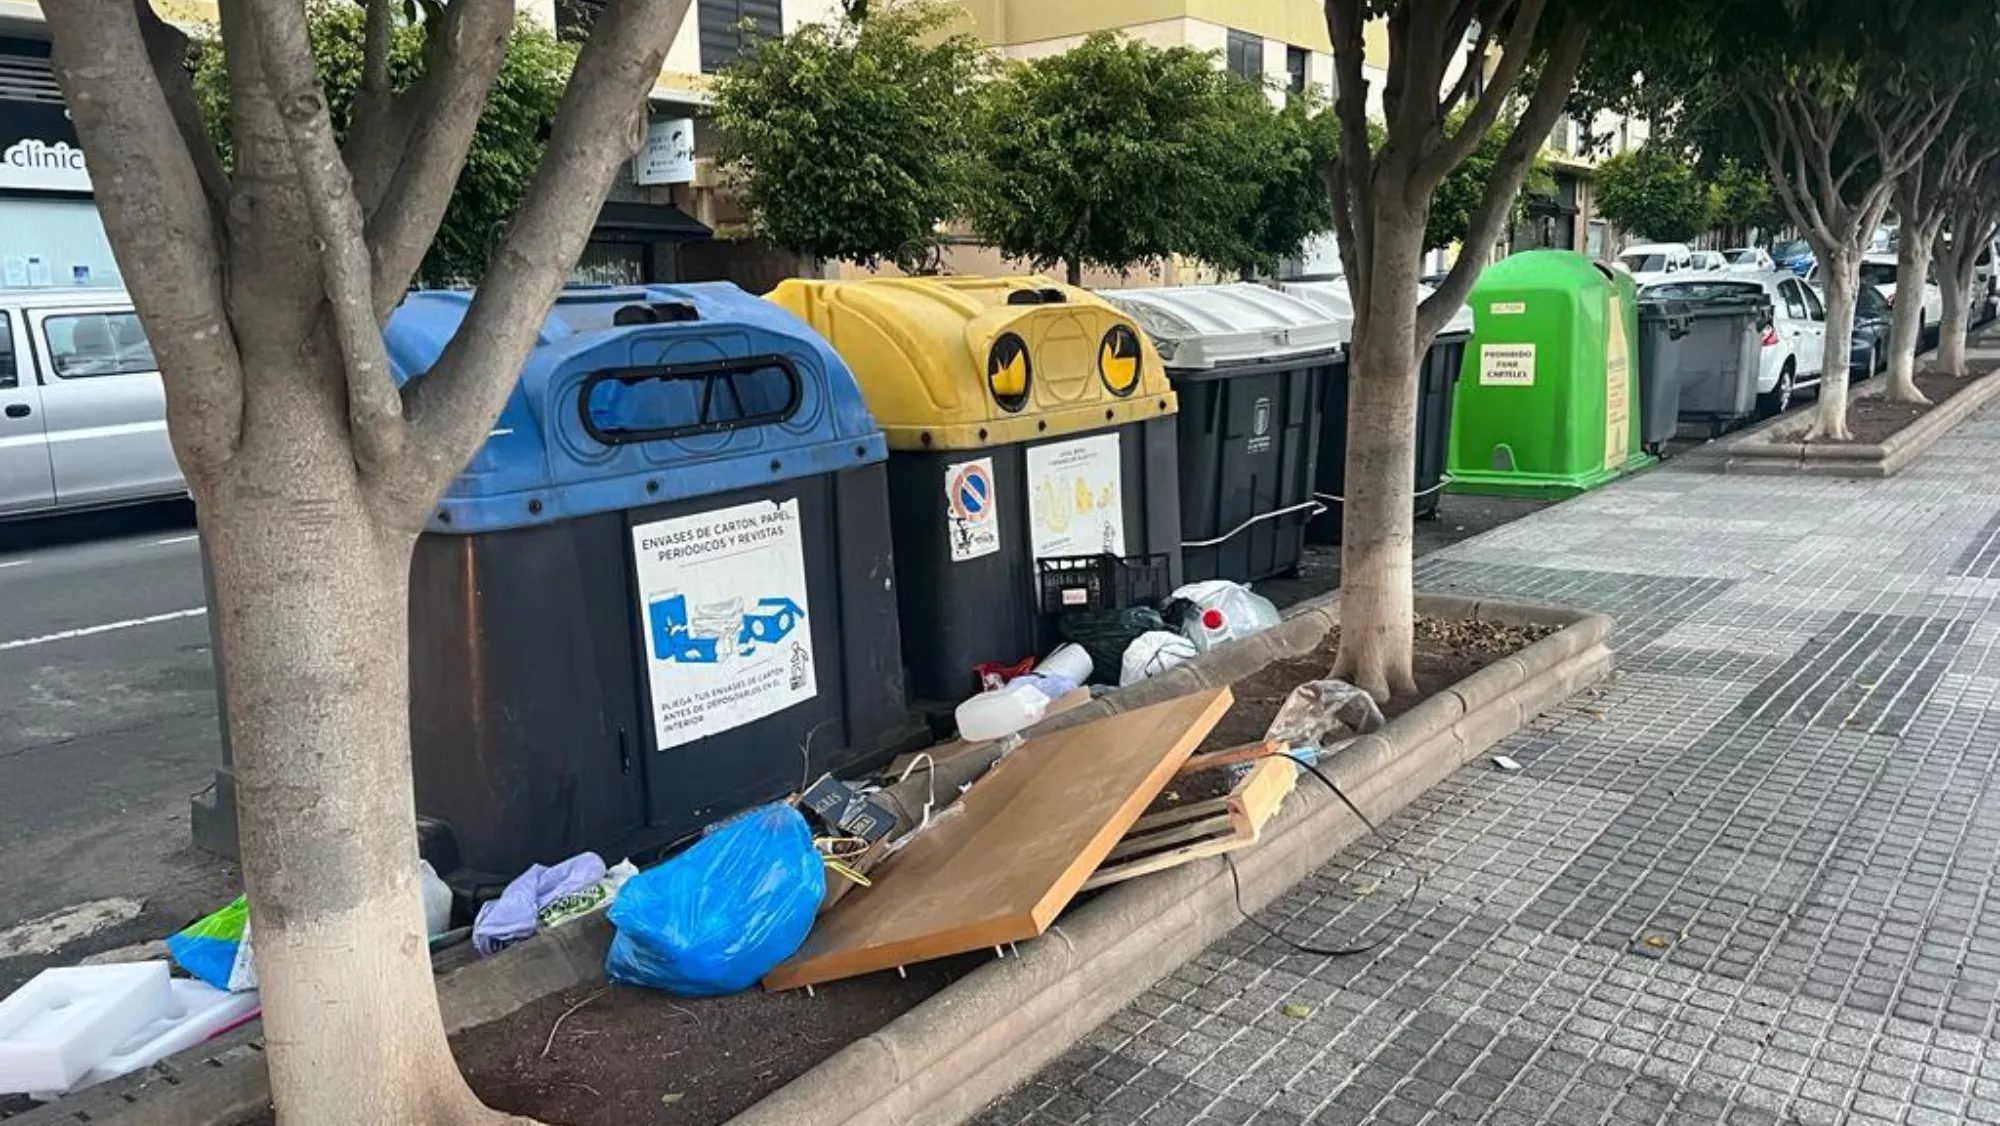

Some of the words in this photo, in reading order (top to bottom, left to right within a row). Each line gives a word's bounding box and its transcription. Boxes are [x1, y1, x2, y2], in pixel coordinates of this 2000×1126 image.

[642, 529, 695, 551] ENVASES
[697, 526, 712, 540] DE
[729, 535, 737, 547] Y
[738, 525, 785, 544] REVISTAS
[661, 696, 693, 712] PLIEGA
[694, 692, 711, 703] TUS
[712, 679, 747, 698] ENVASES
[747, 675, 758, 687] DE
[663, 707, 693, 722] ANTES
[693, 702, 705, 715] DE
[706, 685, 762, 710] DEPOSITARLOS
[762, 681, 773, 692] EN
[663, 714, 705, 733] INTERIOR
